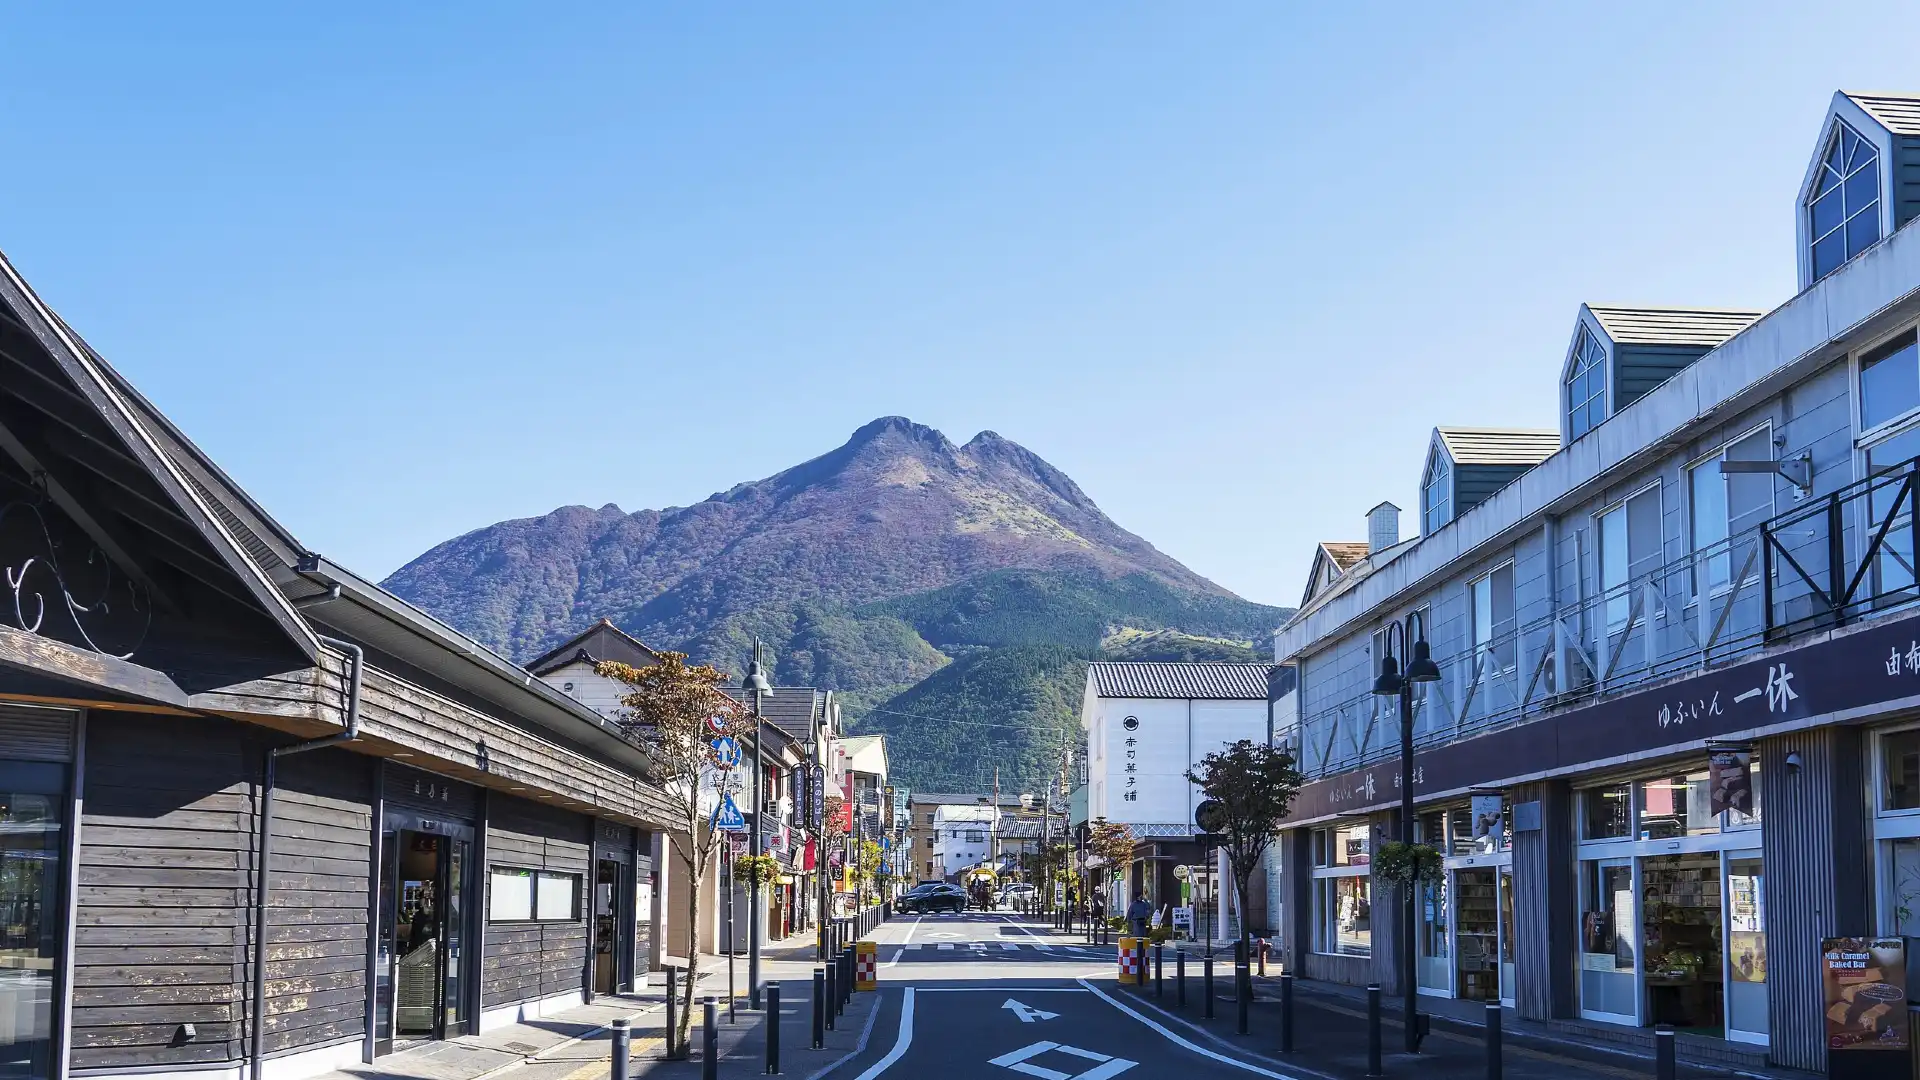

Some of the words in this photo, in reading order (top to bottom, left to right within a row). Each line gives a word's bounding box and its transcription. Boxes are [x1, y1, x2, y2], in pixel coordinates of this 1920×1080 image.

[1658, 691, 1724, 729] ゆふいん
[1733, 663, 1799, 713] 一休
[814, 771, 823, 815] バスのりば
[1355, 773, 1376, 801] 一休
[1824, 952, 1840, 960] Milk
[1841, 952, 1870, 960] Caramel
[1829, 960, 1852, 969] Baked
[1853, 960, 1866, 969] Bar
